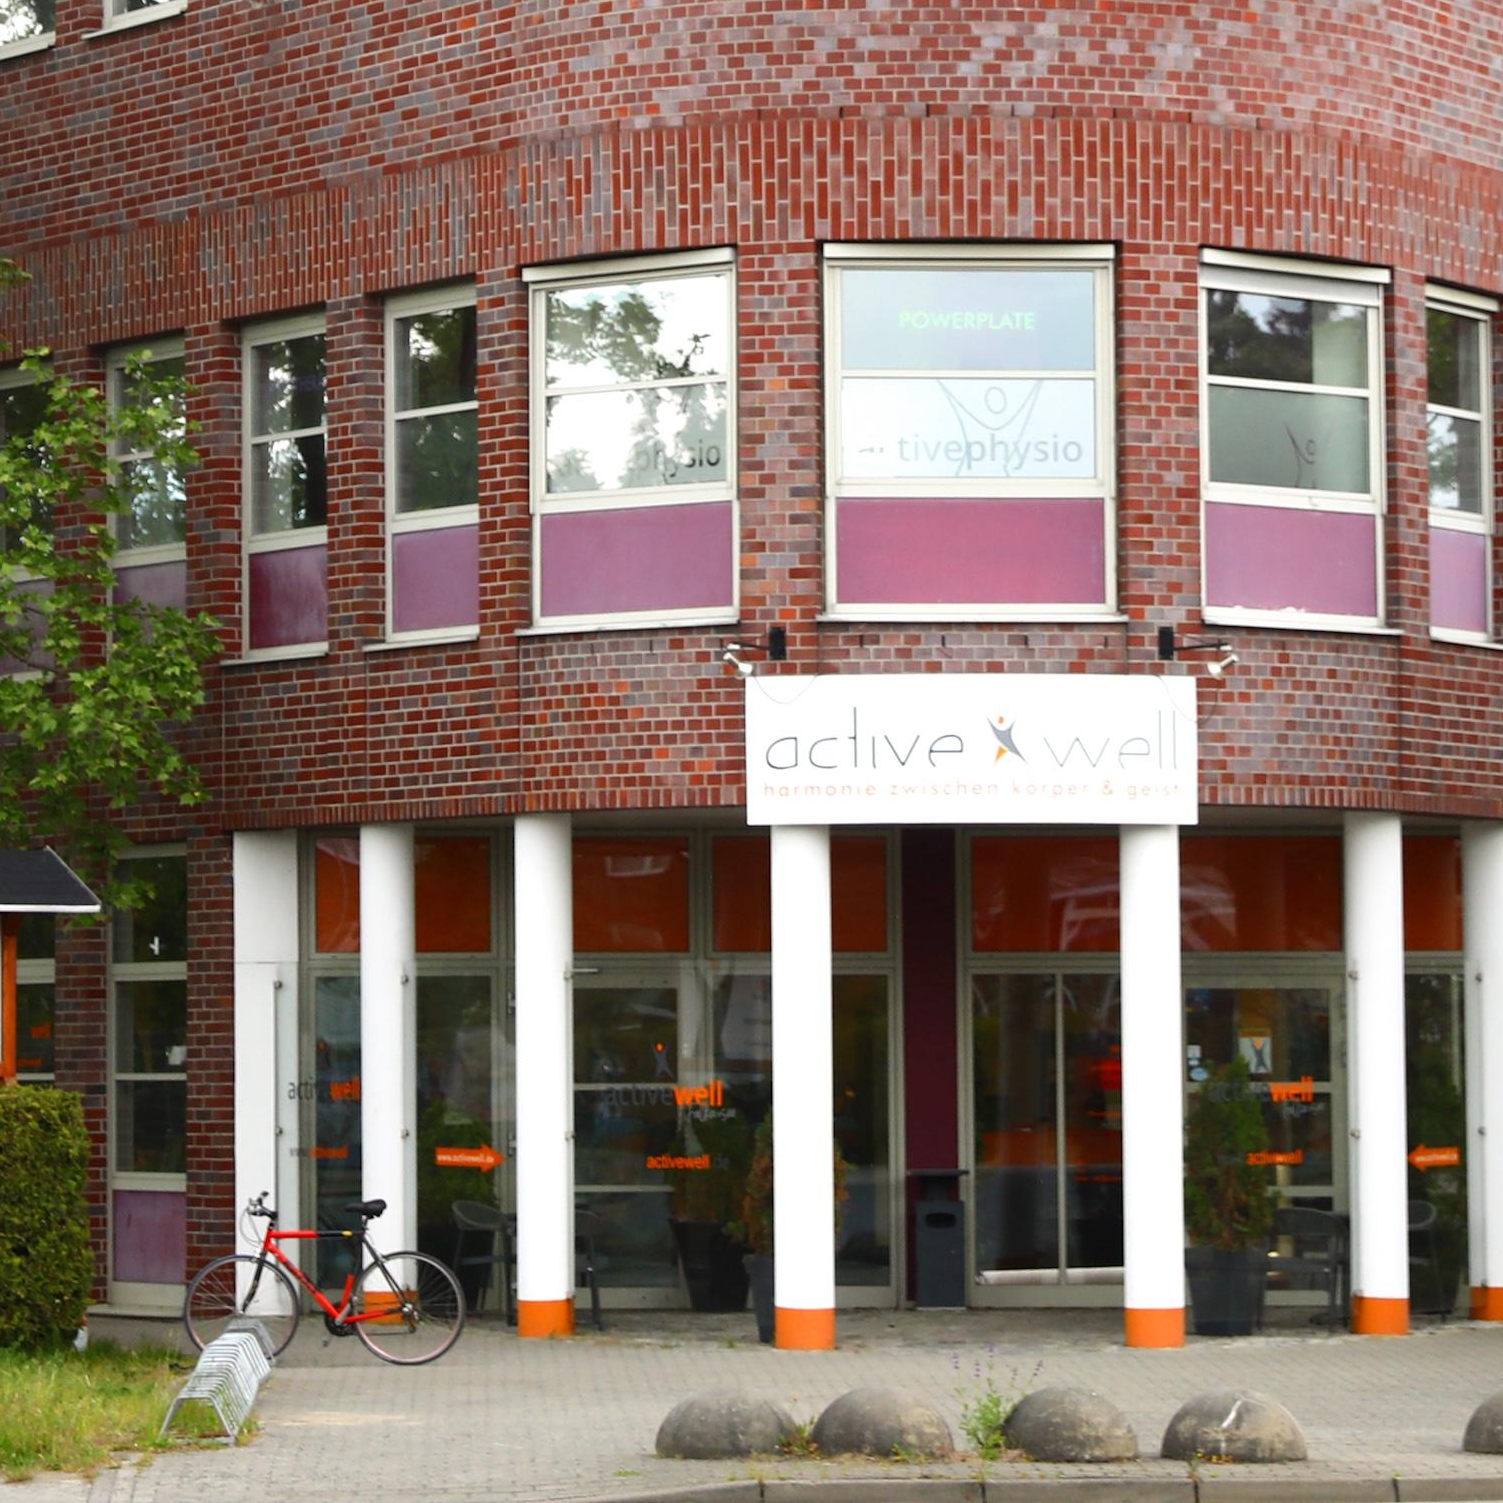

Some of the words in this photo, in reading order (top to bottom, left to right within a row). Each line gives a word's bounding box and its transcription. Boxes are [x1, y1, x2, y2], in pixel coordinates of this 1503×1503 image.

[898, 311, 1037, 330] POWERPLATE
[858, 434, 1084, 471] tivephysio
[764, 706, 964, 770] active
[1043, 709, 1178, 770] well
[763, 781, 877, 797] harmonie
[890, 780, 998, 796] zwischen
[1101, 779, 1115, 796] &
